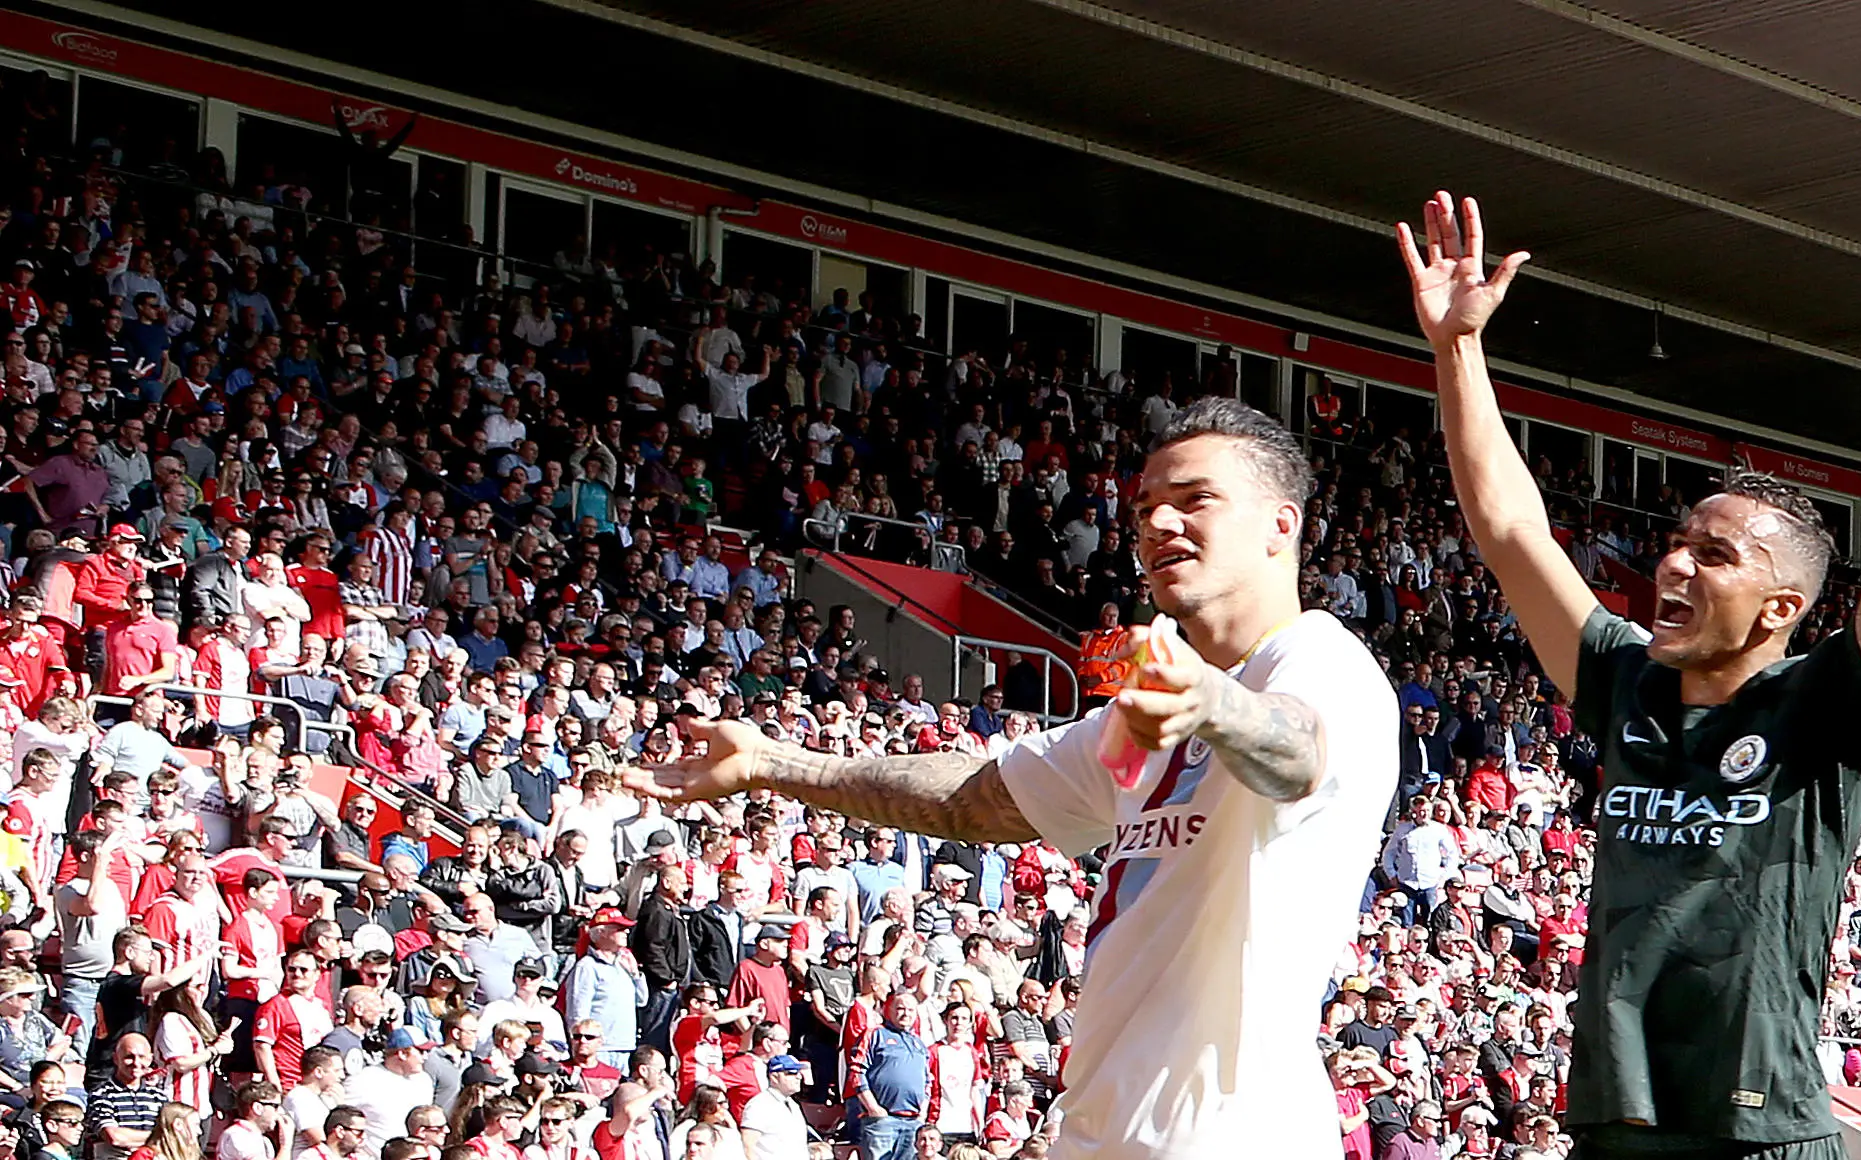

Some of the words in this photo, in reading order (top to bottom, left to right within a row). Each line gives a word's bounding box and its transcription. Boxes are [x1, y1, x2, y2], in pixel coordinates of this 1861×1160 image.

[571, 165, 638, 194] Domino's
[1668, 430, 1708, 452] Systems
[1603, 785, 1772, 825] ETIHAD
[1615, 823, 1725, 847] AIRWAYS
